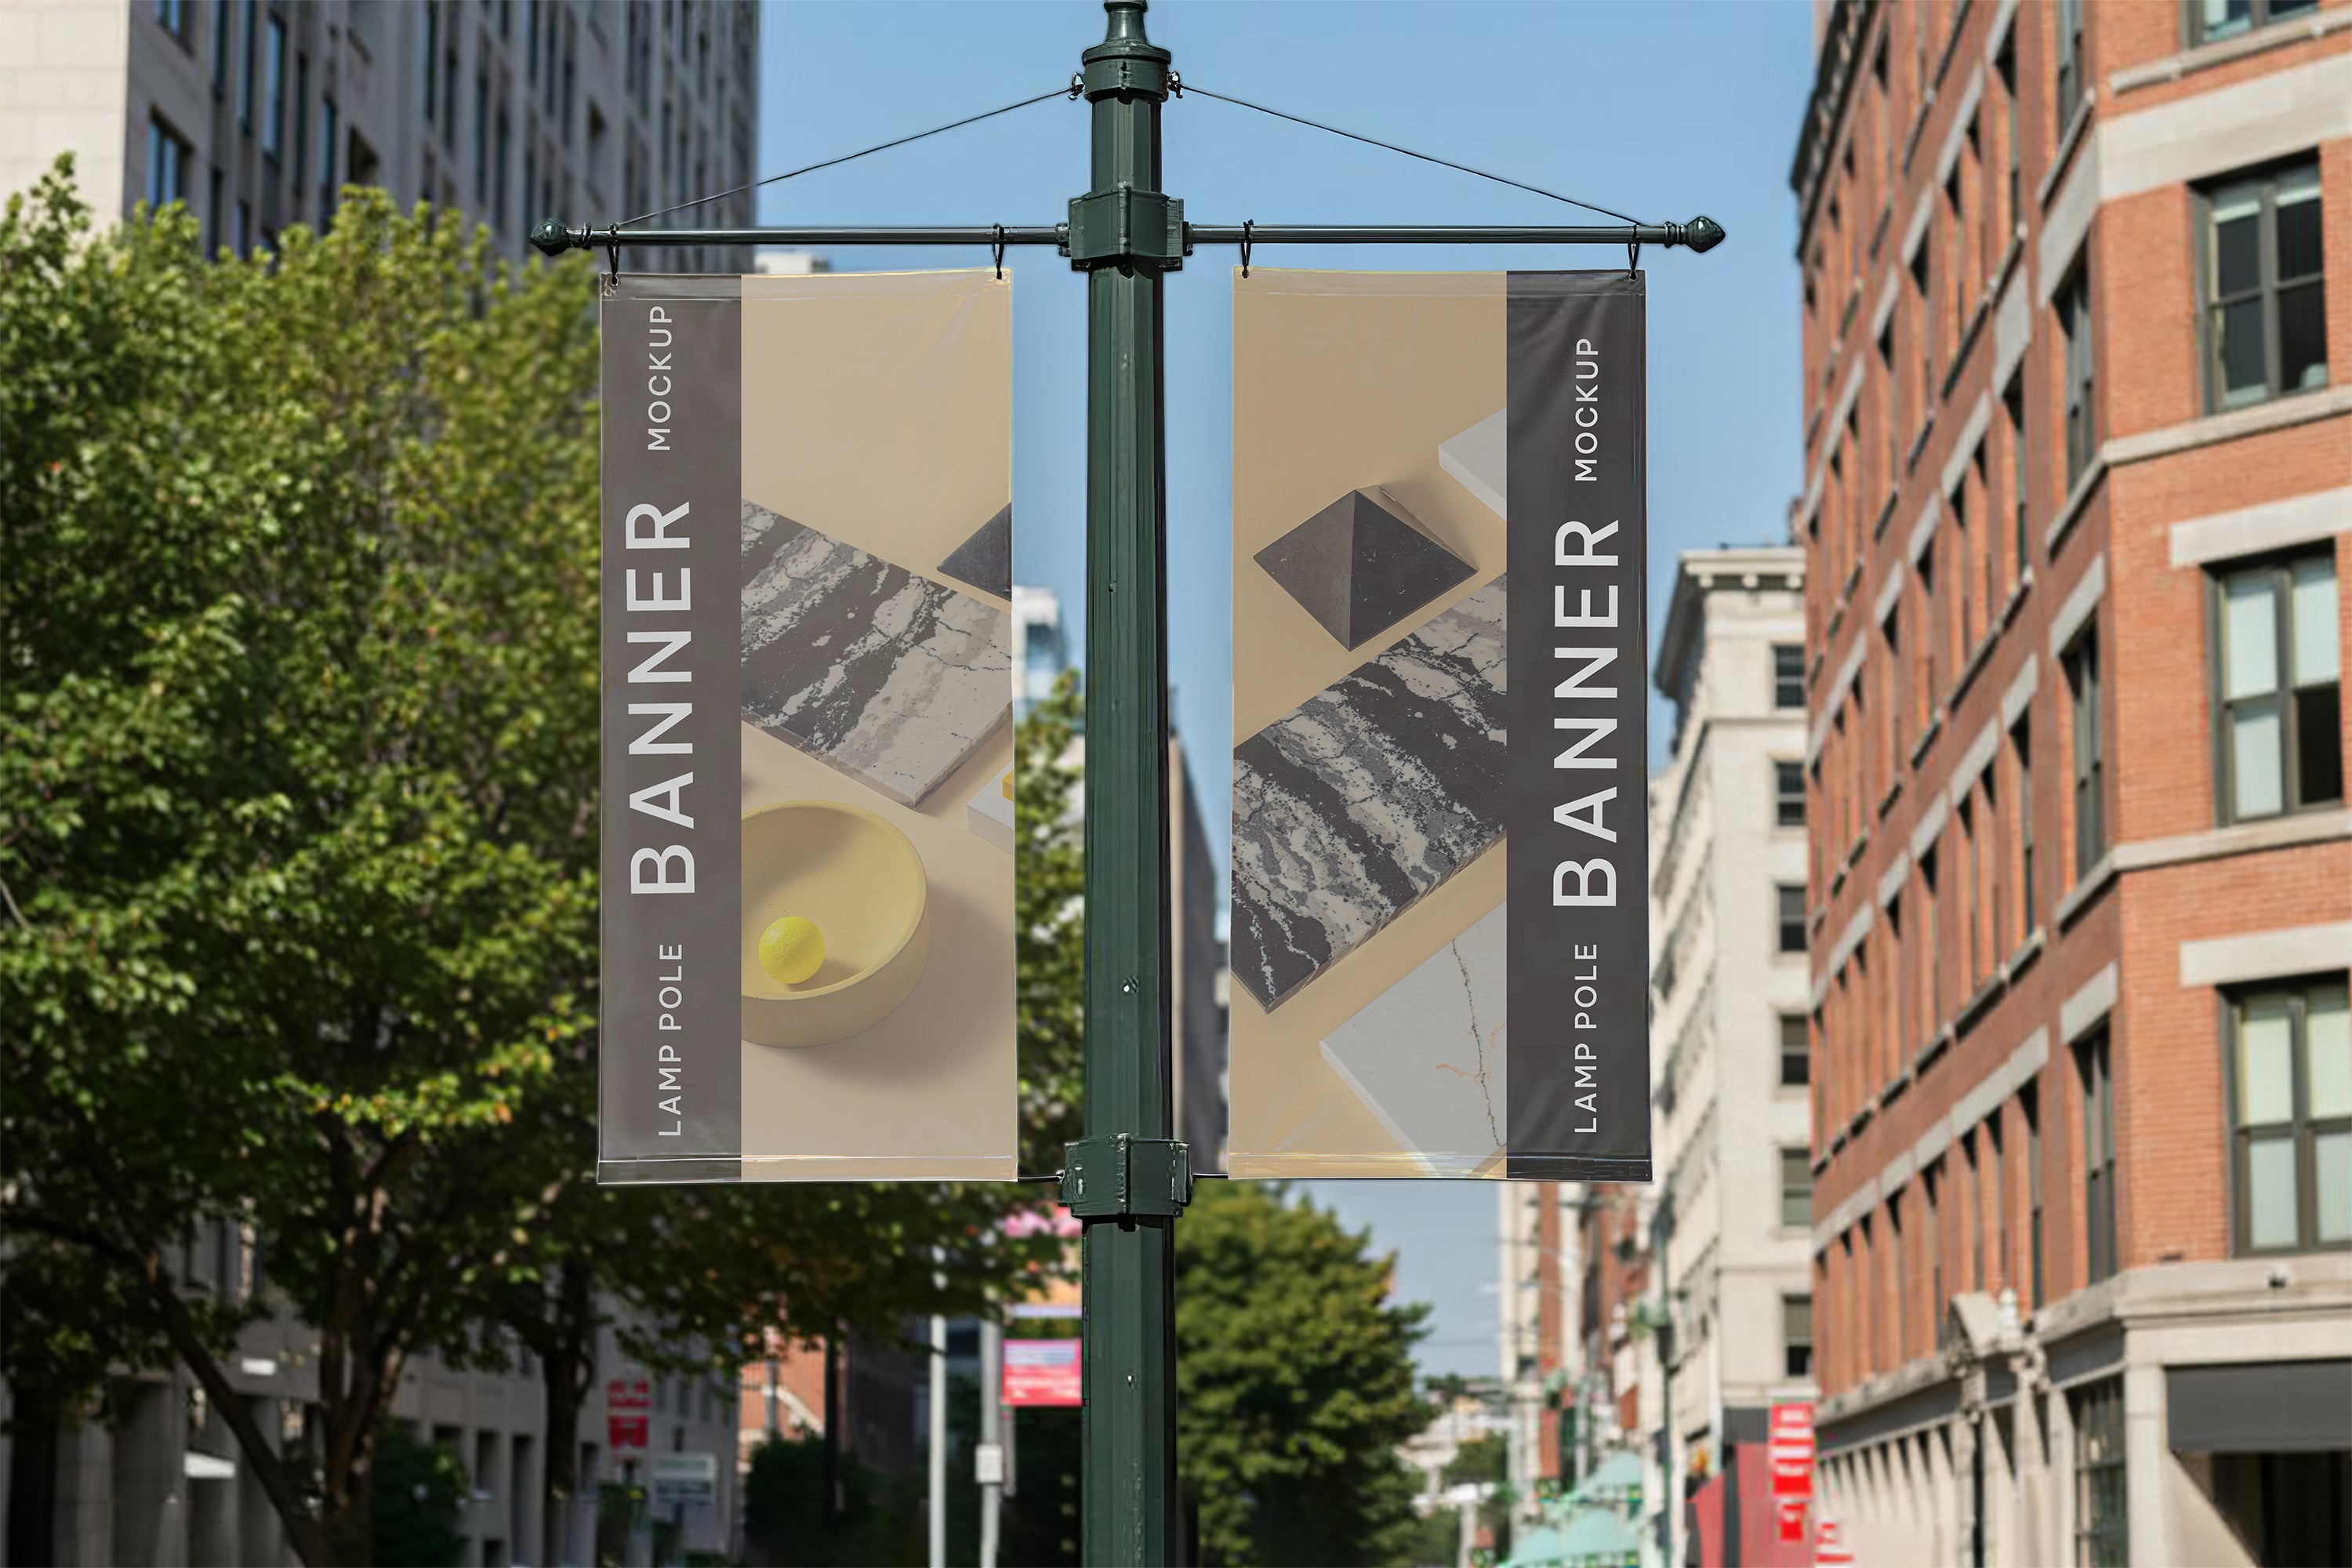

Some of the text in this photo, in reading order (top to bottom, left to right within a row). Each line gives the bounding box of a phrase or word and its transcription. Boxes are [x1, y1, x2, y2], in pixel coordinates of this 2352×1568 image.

[625, 306, 695, 1136] LAMP POLE BANNER MOCKUP
[1552, 338, 1619, 1133] LAMP POLE BANNER MOCKUP
